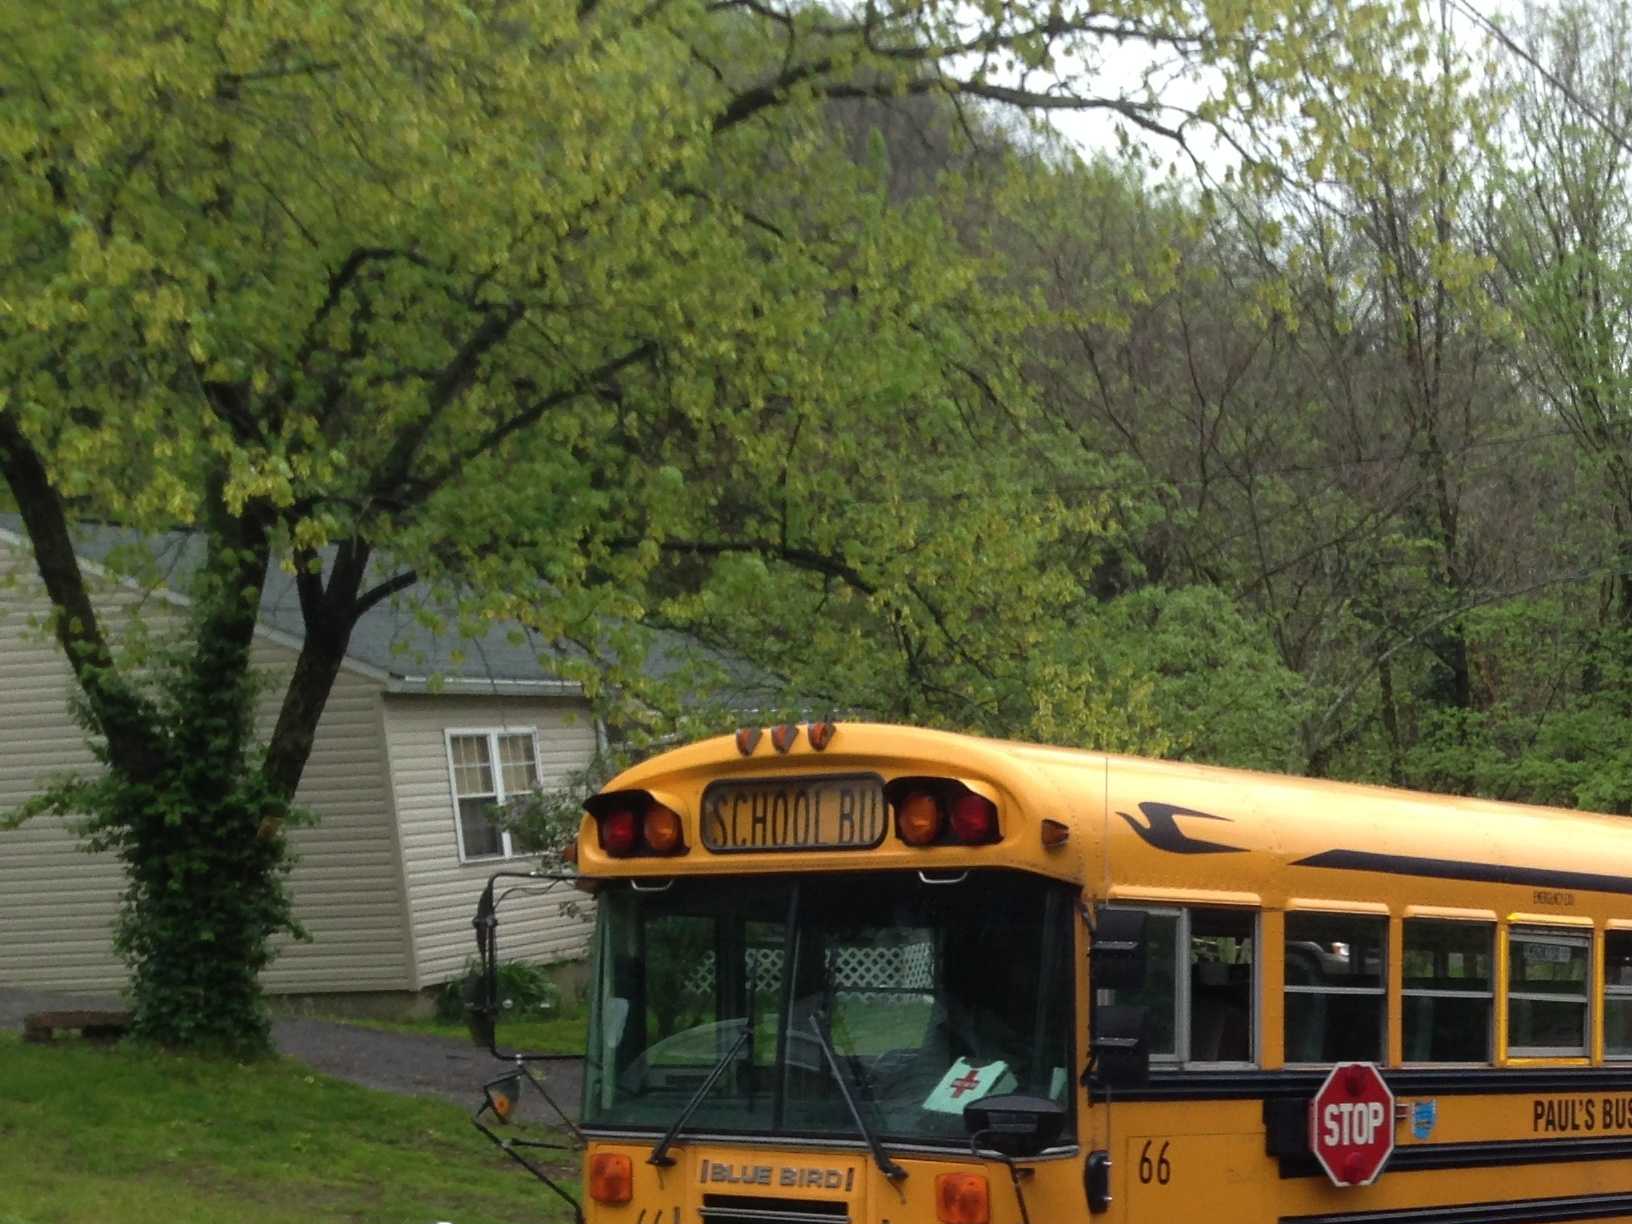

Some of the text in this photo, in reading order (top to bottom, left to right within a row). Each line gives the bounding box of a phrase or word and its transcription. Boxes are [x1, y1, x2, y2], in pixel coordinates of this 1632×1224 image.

[712, 788, 877, 848] SCHOOL BU
[1323, 1102, 1385, 1147] STOP
[1533, 1098, 1596, 1132] PAUL'S
[711, 1163, 842, 1189] BLUE BIRD
[1139, 1140, 1171, 1185] 66
